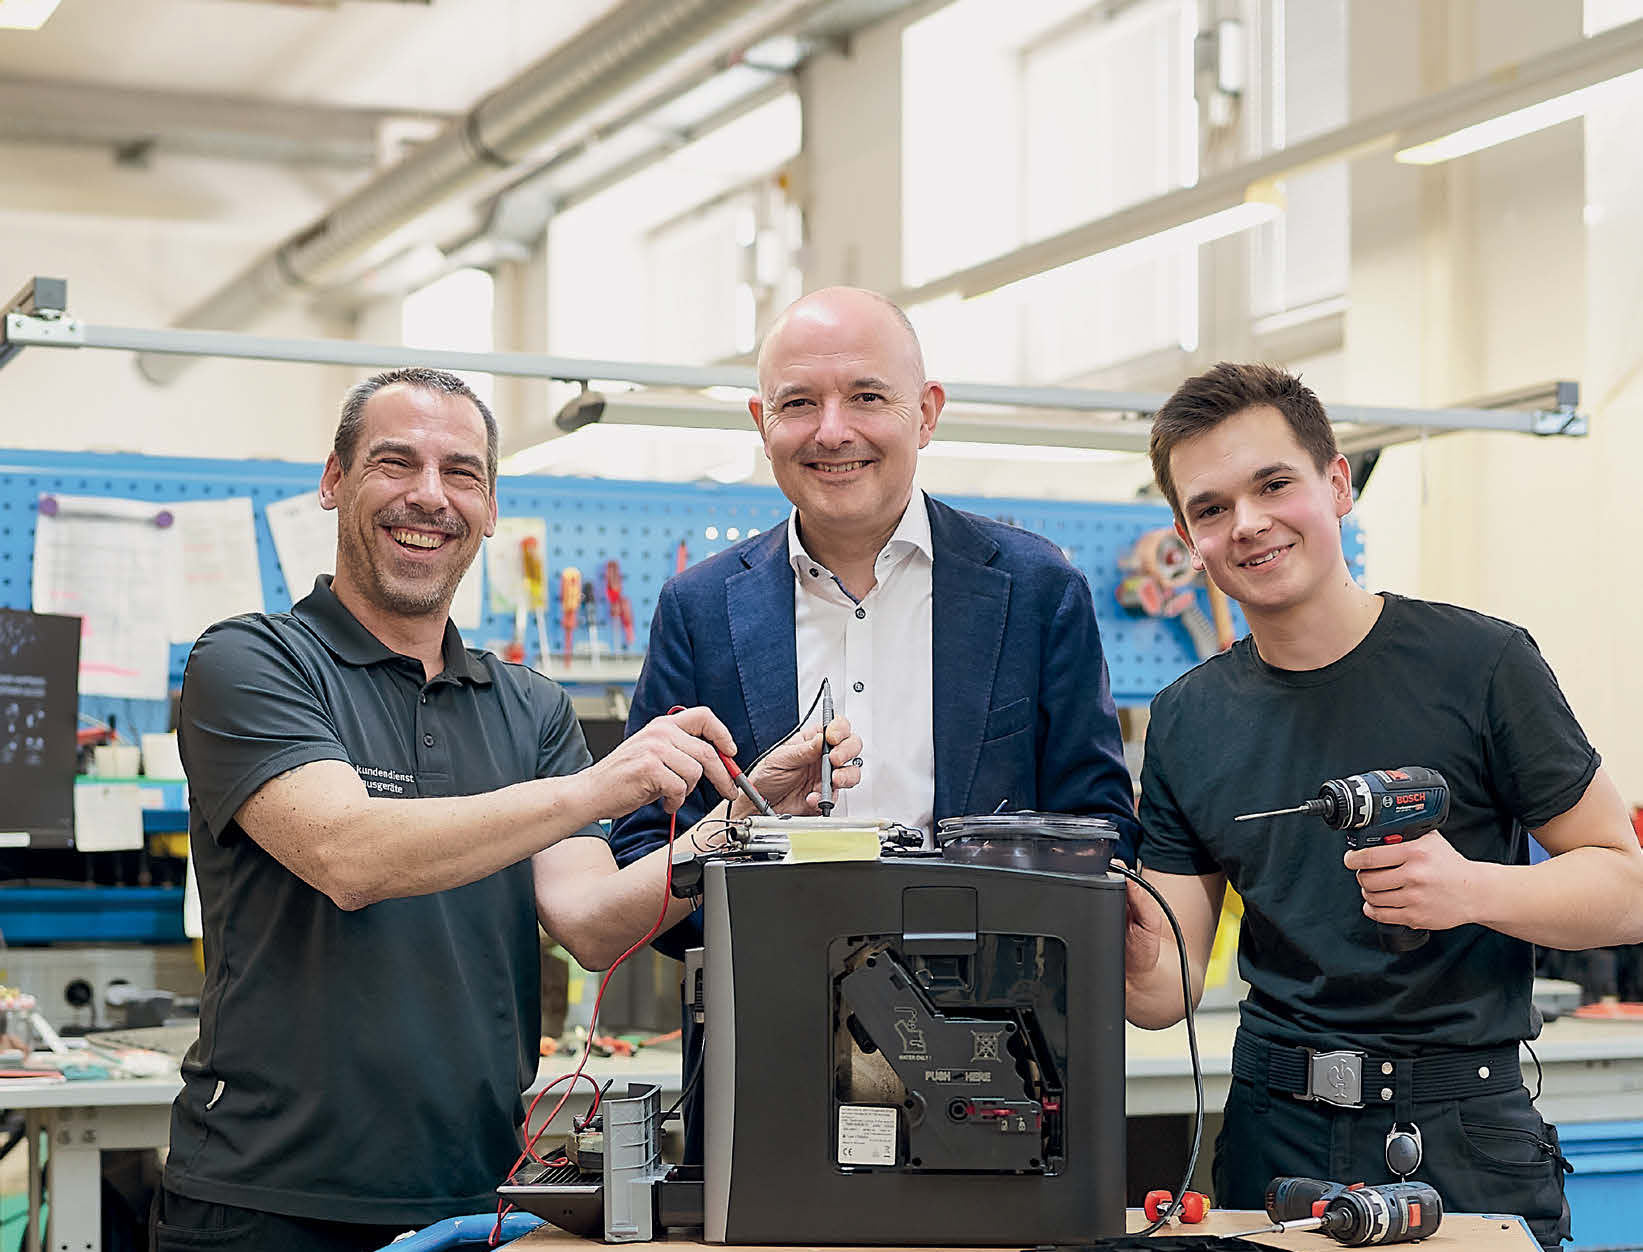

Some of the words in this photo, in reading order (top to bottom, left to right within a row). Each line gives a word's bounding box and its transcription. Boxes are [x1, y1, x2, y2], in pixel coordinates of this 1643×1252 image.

[364, 780, 403, 794] usgeräte
[1396, 792, 1426, 804] BOSCH
[925, 1071, 951, 1081] PUSH
[965, 1071, 992, 1082] HERE
